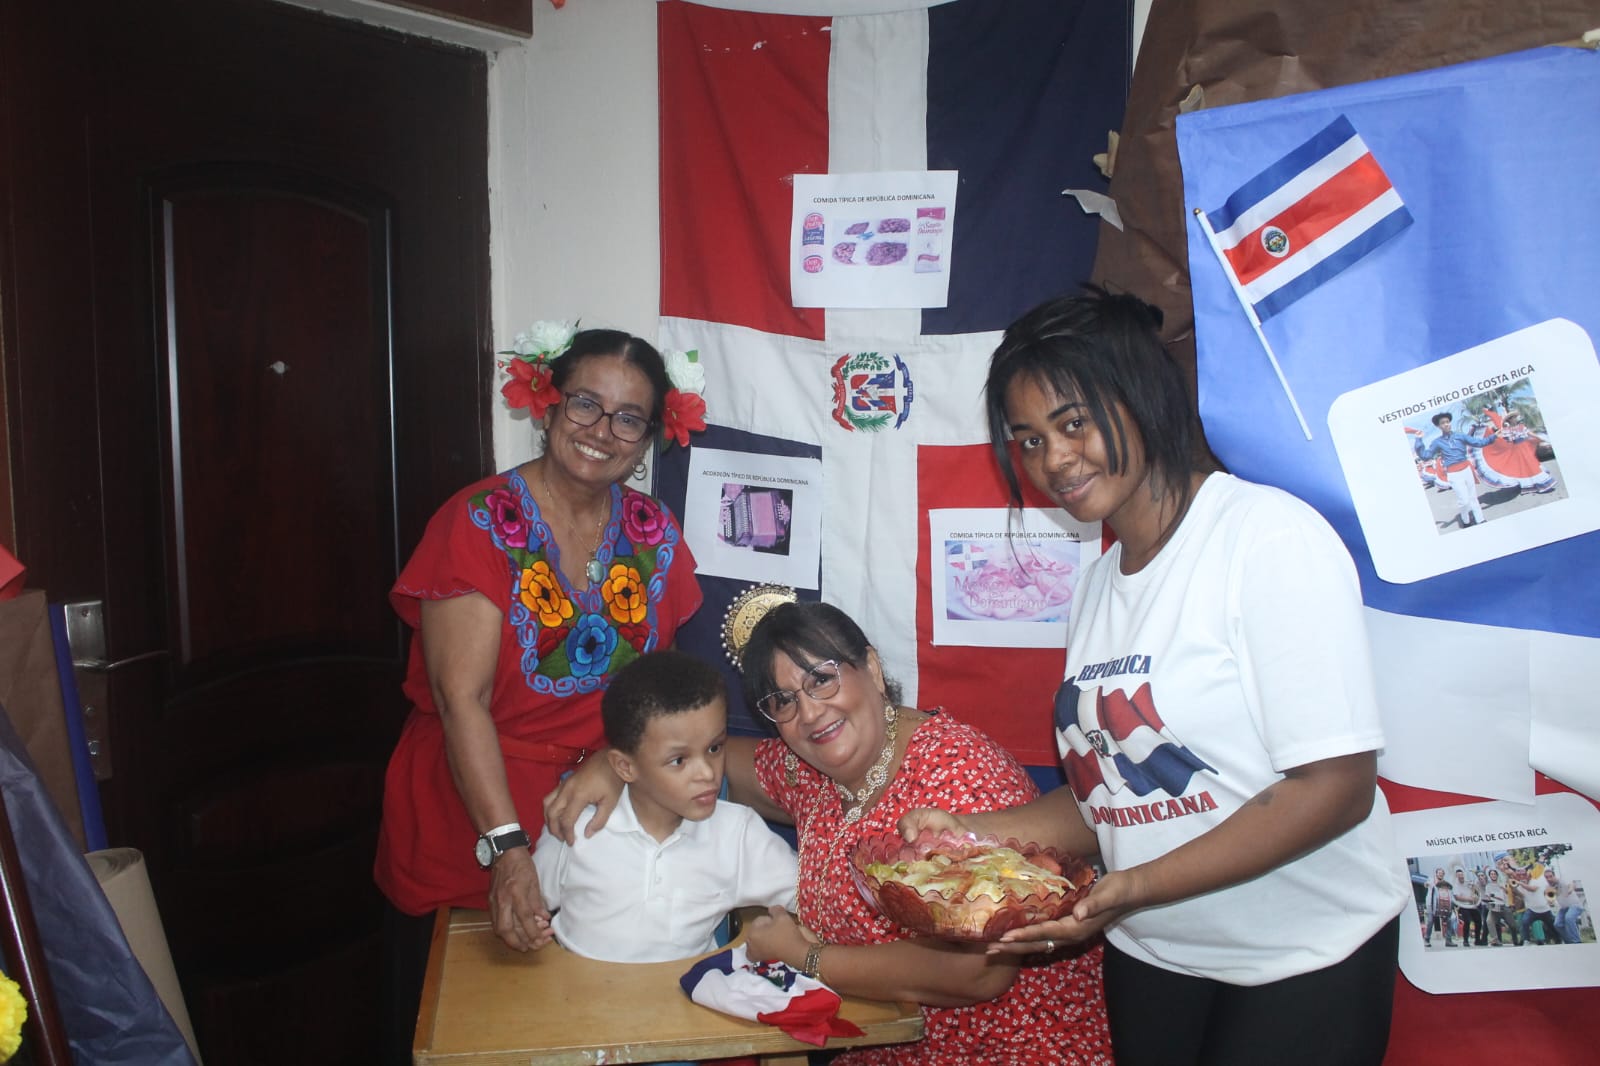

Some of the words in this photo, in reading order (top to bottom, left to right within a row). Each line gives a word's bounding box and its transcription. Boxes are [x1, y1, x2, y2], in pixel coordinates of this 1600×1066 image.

[813, 196, 838, 204] COMIDA
[866, 194, 896, 202] REPÚBLICA
[897, 193, 936, 201] DOMINICANA
[1378, 403, 1427, 424] VESTIDOS
[1428, 390, 1460, 408] TÍPICO
[1461, 384, 1476, 397] DE
[1477, 373, 1510, 391] COSTA
[1511, 364, 1536, 380] RICA
[777, 477, 808, 486] DOMINICANA
[1004, 530, 1037, 539] REPÚBLICA
[1077, 653, 1152, 682] REPÚBLICA
[1089, 790, 1219, 828] DOMINICANA
[1426, 836, 1457, 847] MÚSICA
[1458, 834, 1484, 844] TÍPICA
[1485, 834, 1497, 842] DE
[1497, 830, 1525, 841] COSTA
[1526, 827, 1548, 837] RICA
